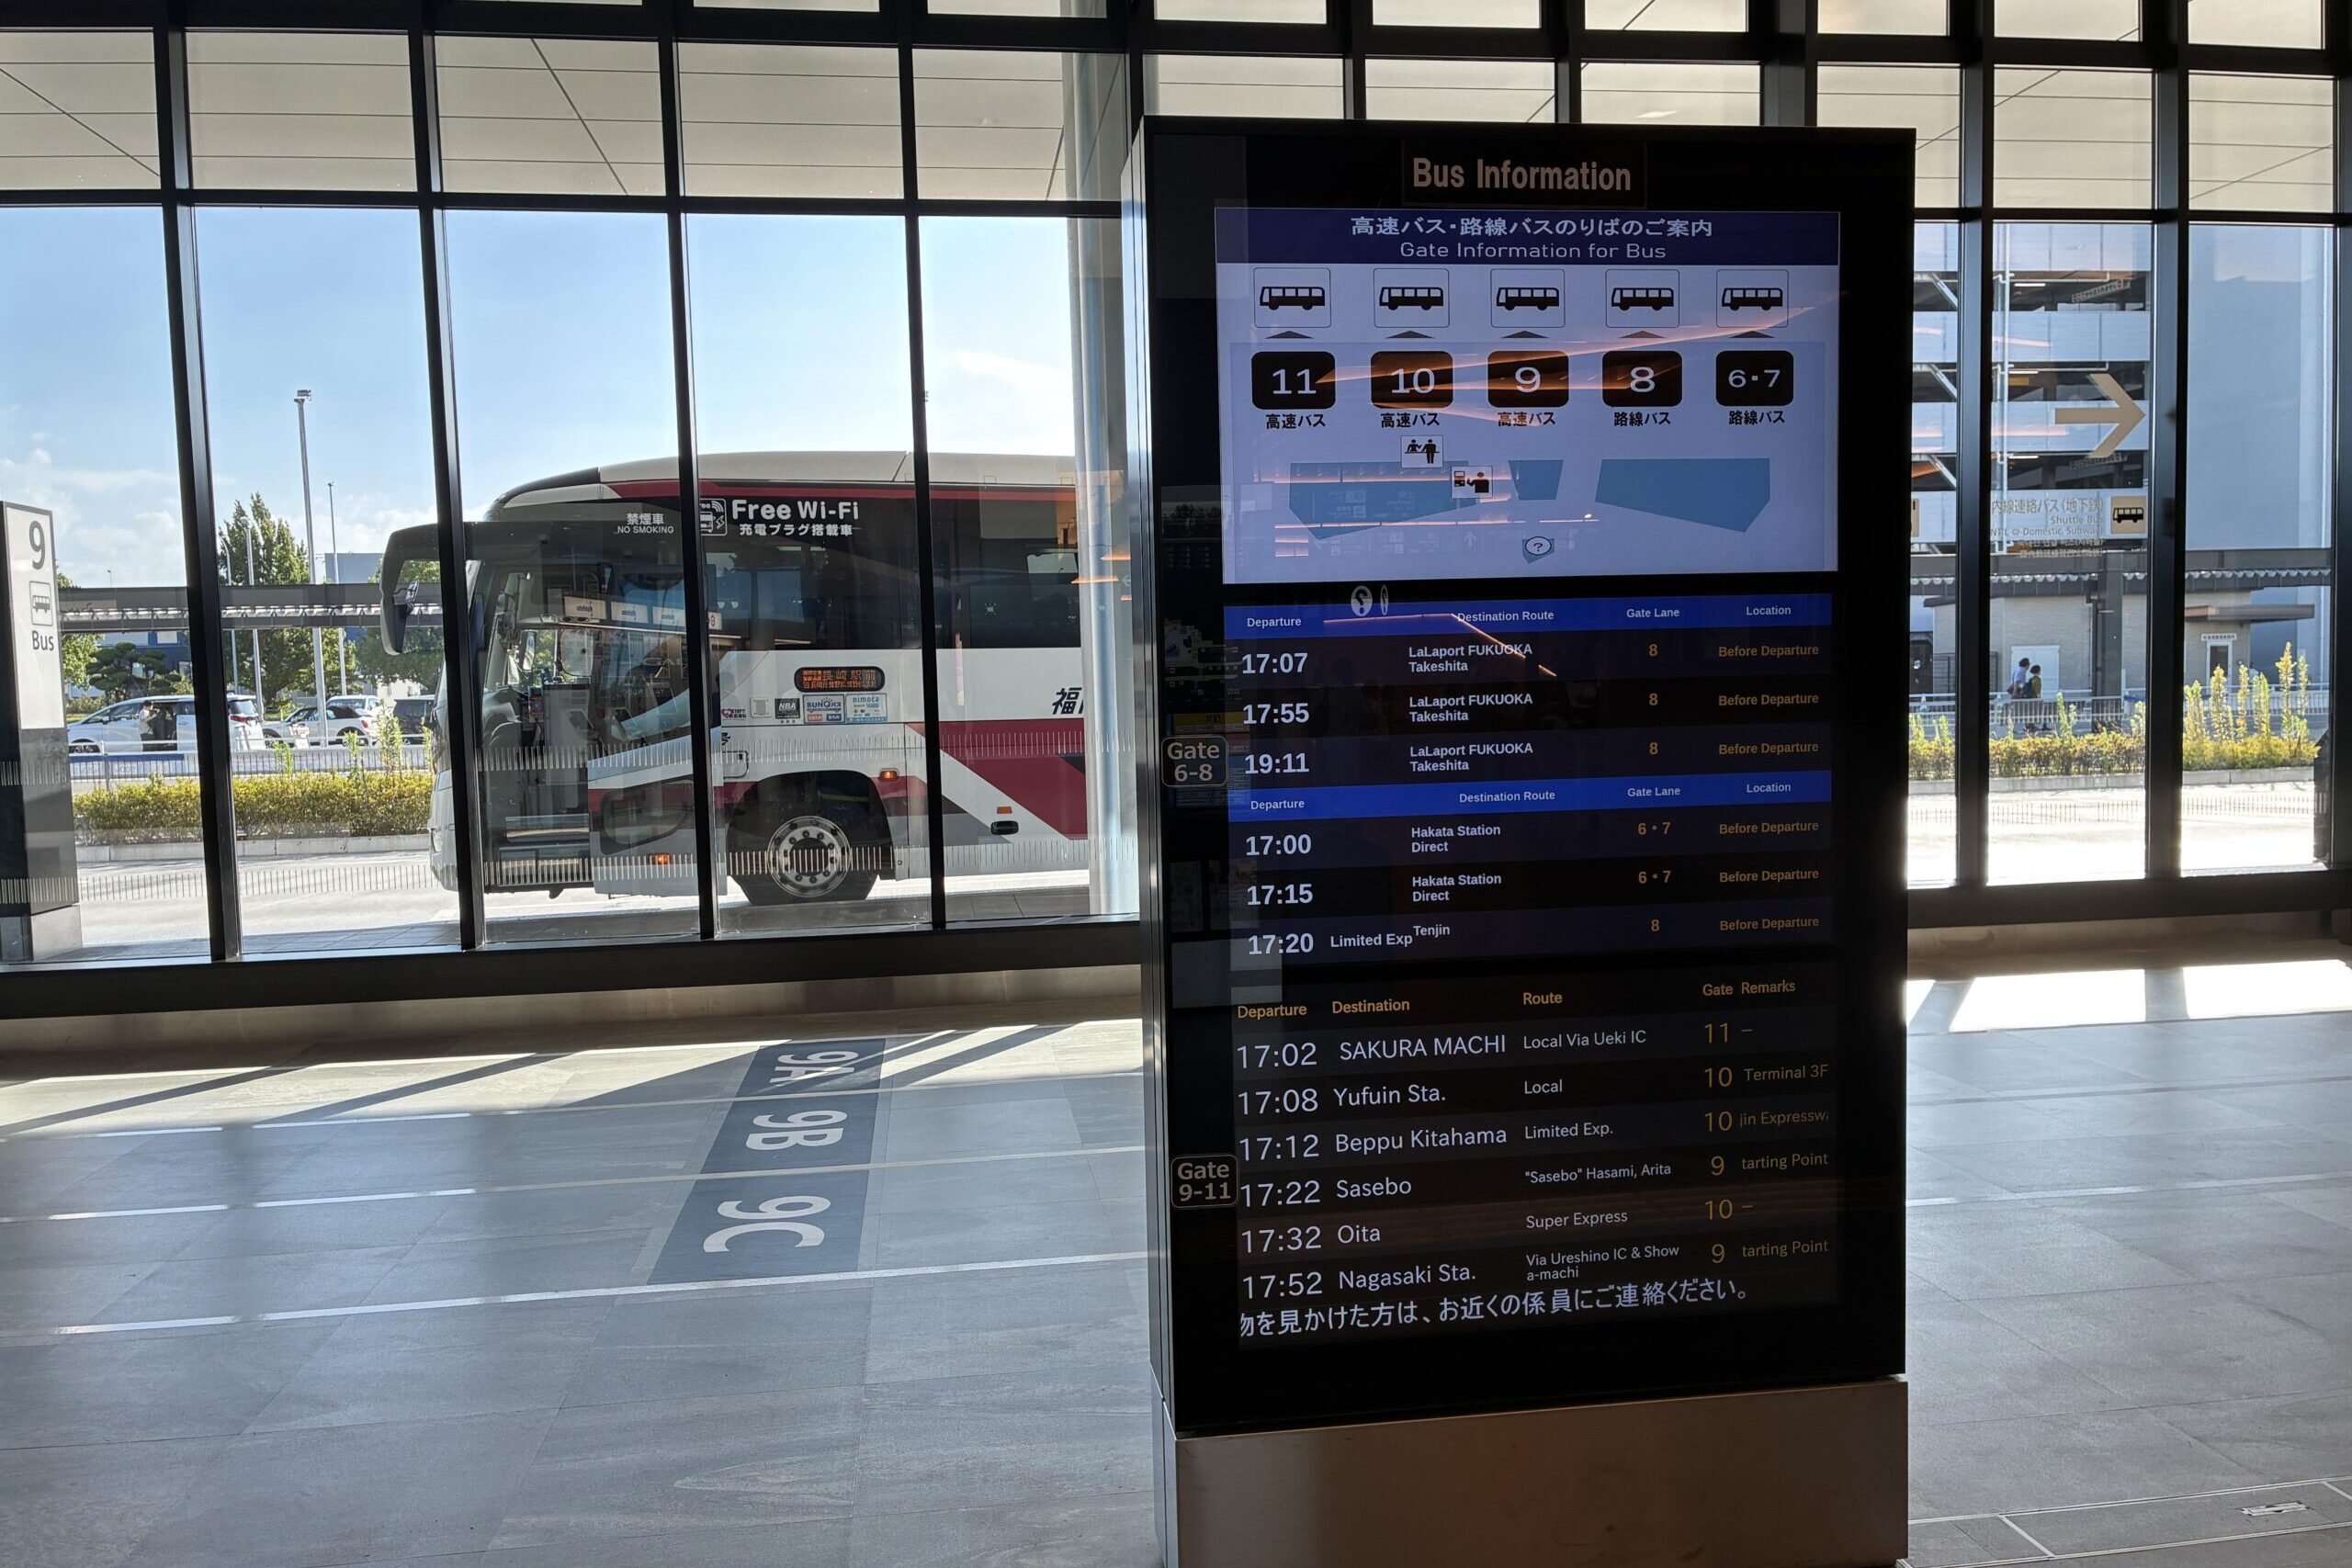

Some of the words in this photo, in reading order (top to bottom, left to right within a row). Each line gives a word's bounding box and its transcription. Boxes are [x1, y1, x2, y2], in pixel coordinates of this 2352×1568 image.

[1414, 158, 1464, 187] Bus
[1477, 159, 1630, 190] Information
[1351, 217, 1712, 237] 高速バス・路線バスのりばのご案内
[1401, 243, 1448, 256] Gate
[1458, 243, 1580, 257] Information
[1589, 243, 1619, 257] for
[1627, 243, 1666, 257] Bus
[1272, 368, 1315, 396] 11
[1391, 367, 1436, 395] 10
[1515, 367, 1542, 395] 9
[1630, 367, 1656, 394] 8
[1265, 412, 1327, 429] 高速バス
[1381, 412, 1441, 428] 高速バス
[1498, 411, 1556, 427] 高速バス
[1613, 411, 1671, 426] 路線バス
[1729, 409, 1786, 425] 路線バス
[732, 499, 792, 520] Free
[797, 501, 858, 520] Wi-Fi
[626, 513, 664, 525] 禁煙車
[2051, 516, 2084, 525] Shuttle
[2087, 515, 2103, 524] Bus
[632, 525, 674, 534] SMOKING
[740, 524, 853, 536] 充電プラグ搭載車
[28, 520, 45, 570] 9
[1458, 610, 1520, 625] Destination
[1522, 611, 1554, 620] Route
[1627, 609, 1651, 617] Gate
[1655, 609, 1679, 617] Lane
[1747, 606, 1791, 615] Location
[1248, 618, 1301, 629] Departure
[32, 630, 54, 652] Bus
[1409, 647, 1464, 659] LaLaport
[1467, 642, 1532, 658] FUKUOKA
[1649, 644, 1657, 656] 8
[1719, 646, 1757, 657] Before
[1761, 646, 1818, 658] Departure
[1243, 653, 1307, 673] 17:07
[1409, 660, 1468, 672] Takeshita
[1052, 687, 1084, 715] 福
[1410, 696, 1464, 708] LaLaport
[1469, 694, 1532, 705] FUKUOKA
[1649, 694, 1657, 705] 8
[1719, 694, 1758, 705] Before
[1761, 694, 1818, 706] Departure
[1244, 703, 1309, 724] 17:55
[1409, 710, 1468, 722] Takeshita
[1168, 742, 1219, 760] Gate
[1410, 746, 1465, 758] LaLaport
[1469, 743, 1532, 755] FUKUOKA
[1650, 742, 1657, 754] 8
[1719, 744, 1758, 754] Before
[1761, 743, 1818, 755] Departure
[1245, 753, 1309, 773] 19:11
[1410, 760, 1469, 772] Takeshita
[1175, 764, 1212, 782] 6-8
[1460, 793, 1520, 802] Destination
[1524, 791, 1555, 800] Route
[1628, 788, 1651, 796] Gate
[1656, 787, 1680, 795] Lane
[1747, 784, 1791, 793] Location
[1251, 800, 1305, 811] Departure
[1412, 827, 1453, 838] Hakata
[1457, 826, 1500, 836] Station
[1720, 823, 1758, 834] Before
[1762, 822, 1818, 834] Departure
[1247, 834, 1311, 855] 17:00
[1412, 841, 1448, 852] Direct
[1413, 875, 1454, 886] Hakata
[1459, 874, 1501, 885] Station
[1720, 871, 1758, 882] Before
[1762, 870, 1818, 882] Departure
[1248, 884, 1313, 905] 17:15
[1413, 890, 1449, 901] Direct
[1413, 924, 1450, 938] Tenjin
[1651, 919, 1659, 931] 8
[1720, 919, 1758, 931] Before
[1762, 918, 1818, 930] Departure
[1249, 933, 1313, 954] 17:20
[1331, 934, 1381, 947] Limited
[1386, 934, 1412, 947] Exp
[1702, 984, 1733, 996] Gate
[1742, 980, 1795, 994] Remarks
[1333, 998, 1409, 1013] Destination
[1523, 993, 1562, 1005] Route
[1238, 1005, 1306, 1020] Departure
[1524, 1034, 1561, 1048] Local
[1566, 1033, 1589, 1046] Via
[1595, 1032, 1623, 1044] Ueki
[1632, 1031, 1645, 1043] IC
[1705, 1023, 1727, 1043] 11
[1238, 1043, 1317, 1068] 17:02
[1340, 1039, 1427, 1060] SAKURA
[1434, 1035, 1505, 1055] MACHI
[770, 1050, 859, 1087] 9A
[1744, 1066, 1805, 1081] Terminal
[1811, 1065, 1828, 1077] 3F
[1705, 1067, 1732, 1088] 10
[1525, 1079, 1562, 1094] Local
[1238, 1089, 1317, 1114] 17:08
[1333, 1087, 1400, 1106] Yufuin
[1408, 1085, 1445, 1102] Sta.
[1705, 1111, 1732, 1132] 10
[746, 1110, 847, 1151] 9B
[1525, 1123, 1577, 1139] Limited
[1584, 1122, 1612, 1137] Exp.
[1240, 1134, 1318, 1160] 17:12
[1337, 1134, 1402, 1155] Beppu
[1411, 1128, 1507, 1147] Kitahama
[1712, 1156, 1724, 1176] 9
[1792, 1154, 1827, 1166] Point
[1178, 1162, 1229, 1179] Gate
[1525, 1168, 1582, 1183] "Sasebo"
[1587, 1165, 1636, 1179] Hasami,
[1641, 1164, 1670, 1176] Arita
[1180, 1182, 1230, 1201] 9-11
[1241, 1180, 1320, 1207] 17:22
[1337, 1177, 1411, 1198] Sasebo
[1705, 1200, 1732, 1220] 10
[703, 1195, 831, 1253] 9C
[1527, 1216, 1568, 1230] Super
[1574, 1213, 1627, 1226] Express
[1242, 1226, 1321, 1253] 17:32
[1338, 1225, 1380, 1243] Oita
[1712, 1244, 1724, 1263] 9
[1792, 1240, 1827, 1254] Point
[1526, 1255, 1546, 1266] Via
[1552, 1250, 1609, 1264] Ureshino
[1614, 1248, 1626, 1259] IC
[1632, 1247, 1640, 1258] &
[1645, 1246, 1679, 1258] Show
[1340, 1266, 1430, 1291] Nagasaki
[1440, 1264, 1475, 1281] Sta.
[1527, 1266, 1578, 1280] a-machi
[1243, 1272, 1322, 1298] 17:52
